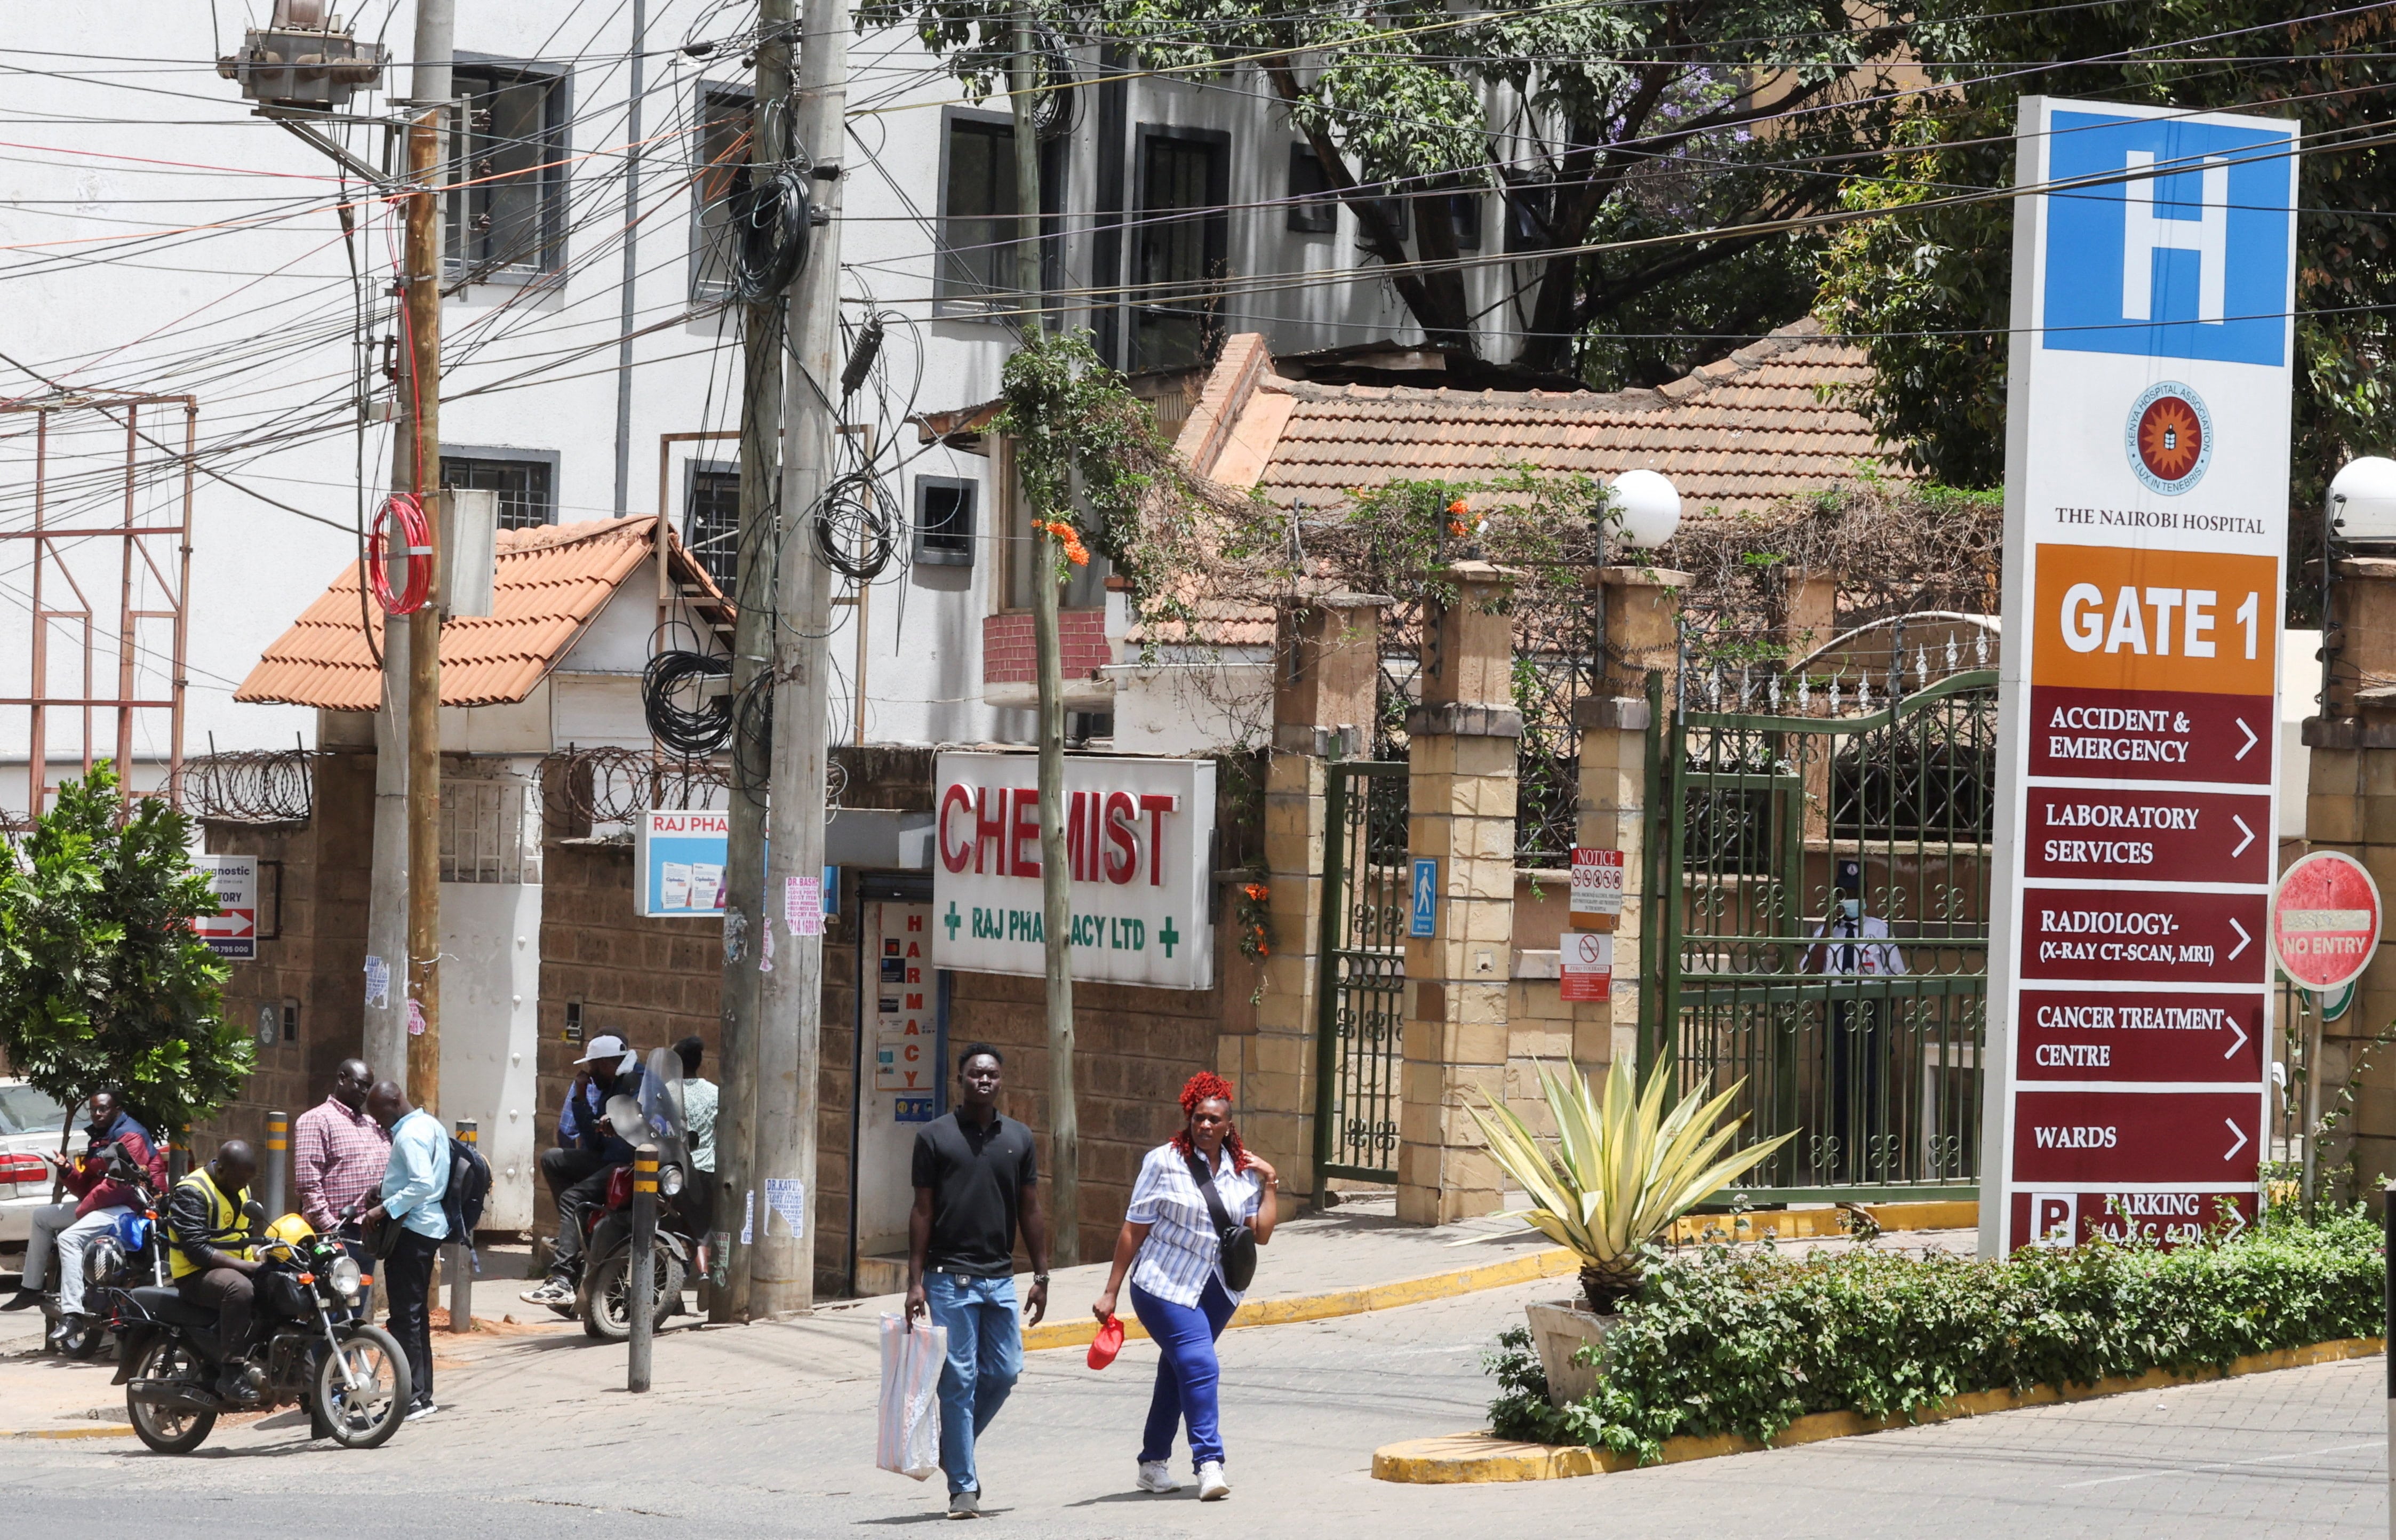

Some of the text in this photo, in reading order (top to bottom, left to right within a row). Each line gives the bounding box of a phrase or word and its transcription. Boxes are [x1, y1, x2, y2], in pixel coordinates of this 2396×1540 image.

[2122, 150, 2229, 325] H
[2128, 385, 2210, 452] KENYA HOSPITAL ASSOCIATION
[2135, 462, 2202, 492] LUX IN TENEBRIS
[2055, 507, 2265, 535] THE NAIROBI HOSPITAL
[2060, 583, 2258, 660] GATE 1
[2049, 706, 2190, 733] ACCIDENT &
[2049, 736, 2189, 763] EMERGENCY
[653, 817, 729, 832] RAJ PHA
[2045, 804, 2199, 830] LABORATORY
[1578, 849, 1616, 866] NOTICE
[2044, 840, 2153, 864] SERVICES
[194, 865, 250, 877] Diagnostic
[972, 907, 1145, 951] RAJ PHAACY LTD
[2041, 910, 2178, 936] RADIOLOGY-
[2040, 942, 2214, 967] (X-RAY CT-SCAN, MRI)
[2282, 936, 2367, 955] NO ENTRY
[904, 914, 923, 1088] HARMACY
[2037, 1006, 2224, 1030] CANCER TREATMENT
[2035, 1044, 2110, 1067] CENTRE
[2034, 1126, 2117, 1148] WARDS
[2105, 1194, 2199, 1216] PARKING
